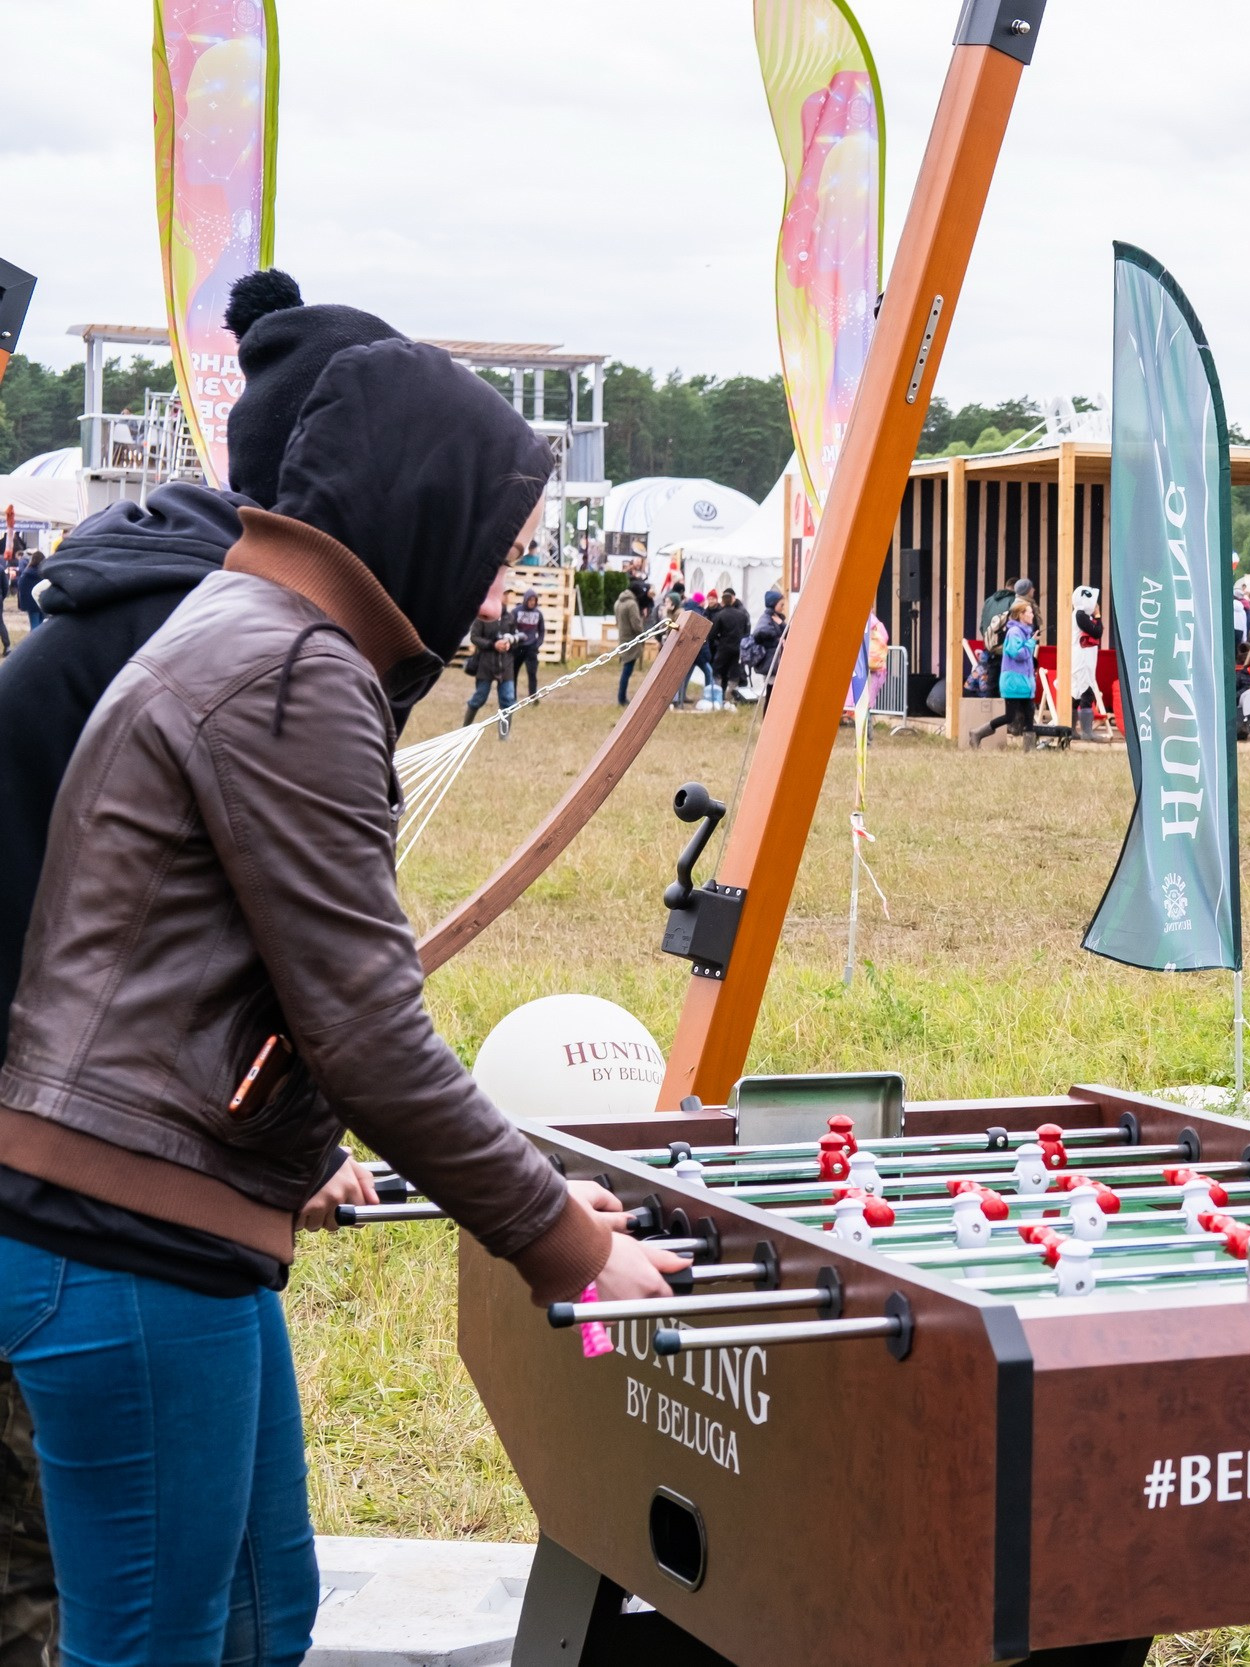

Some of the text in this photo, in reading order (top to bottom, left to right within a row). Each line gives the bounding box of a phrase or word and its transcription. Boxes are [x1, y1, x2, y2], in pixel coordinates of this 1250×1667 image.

[562, 1041, 666, 1067] HUNTIN
[592, 1067, 613, 1082] BY
[626, 1376, 741, 1475] BY BELUGA
